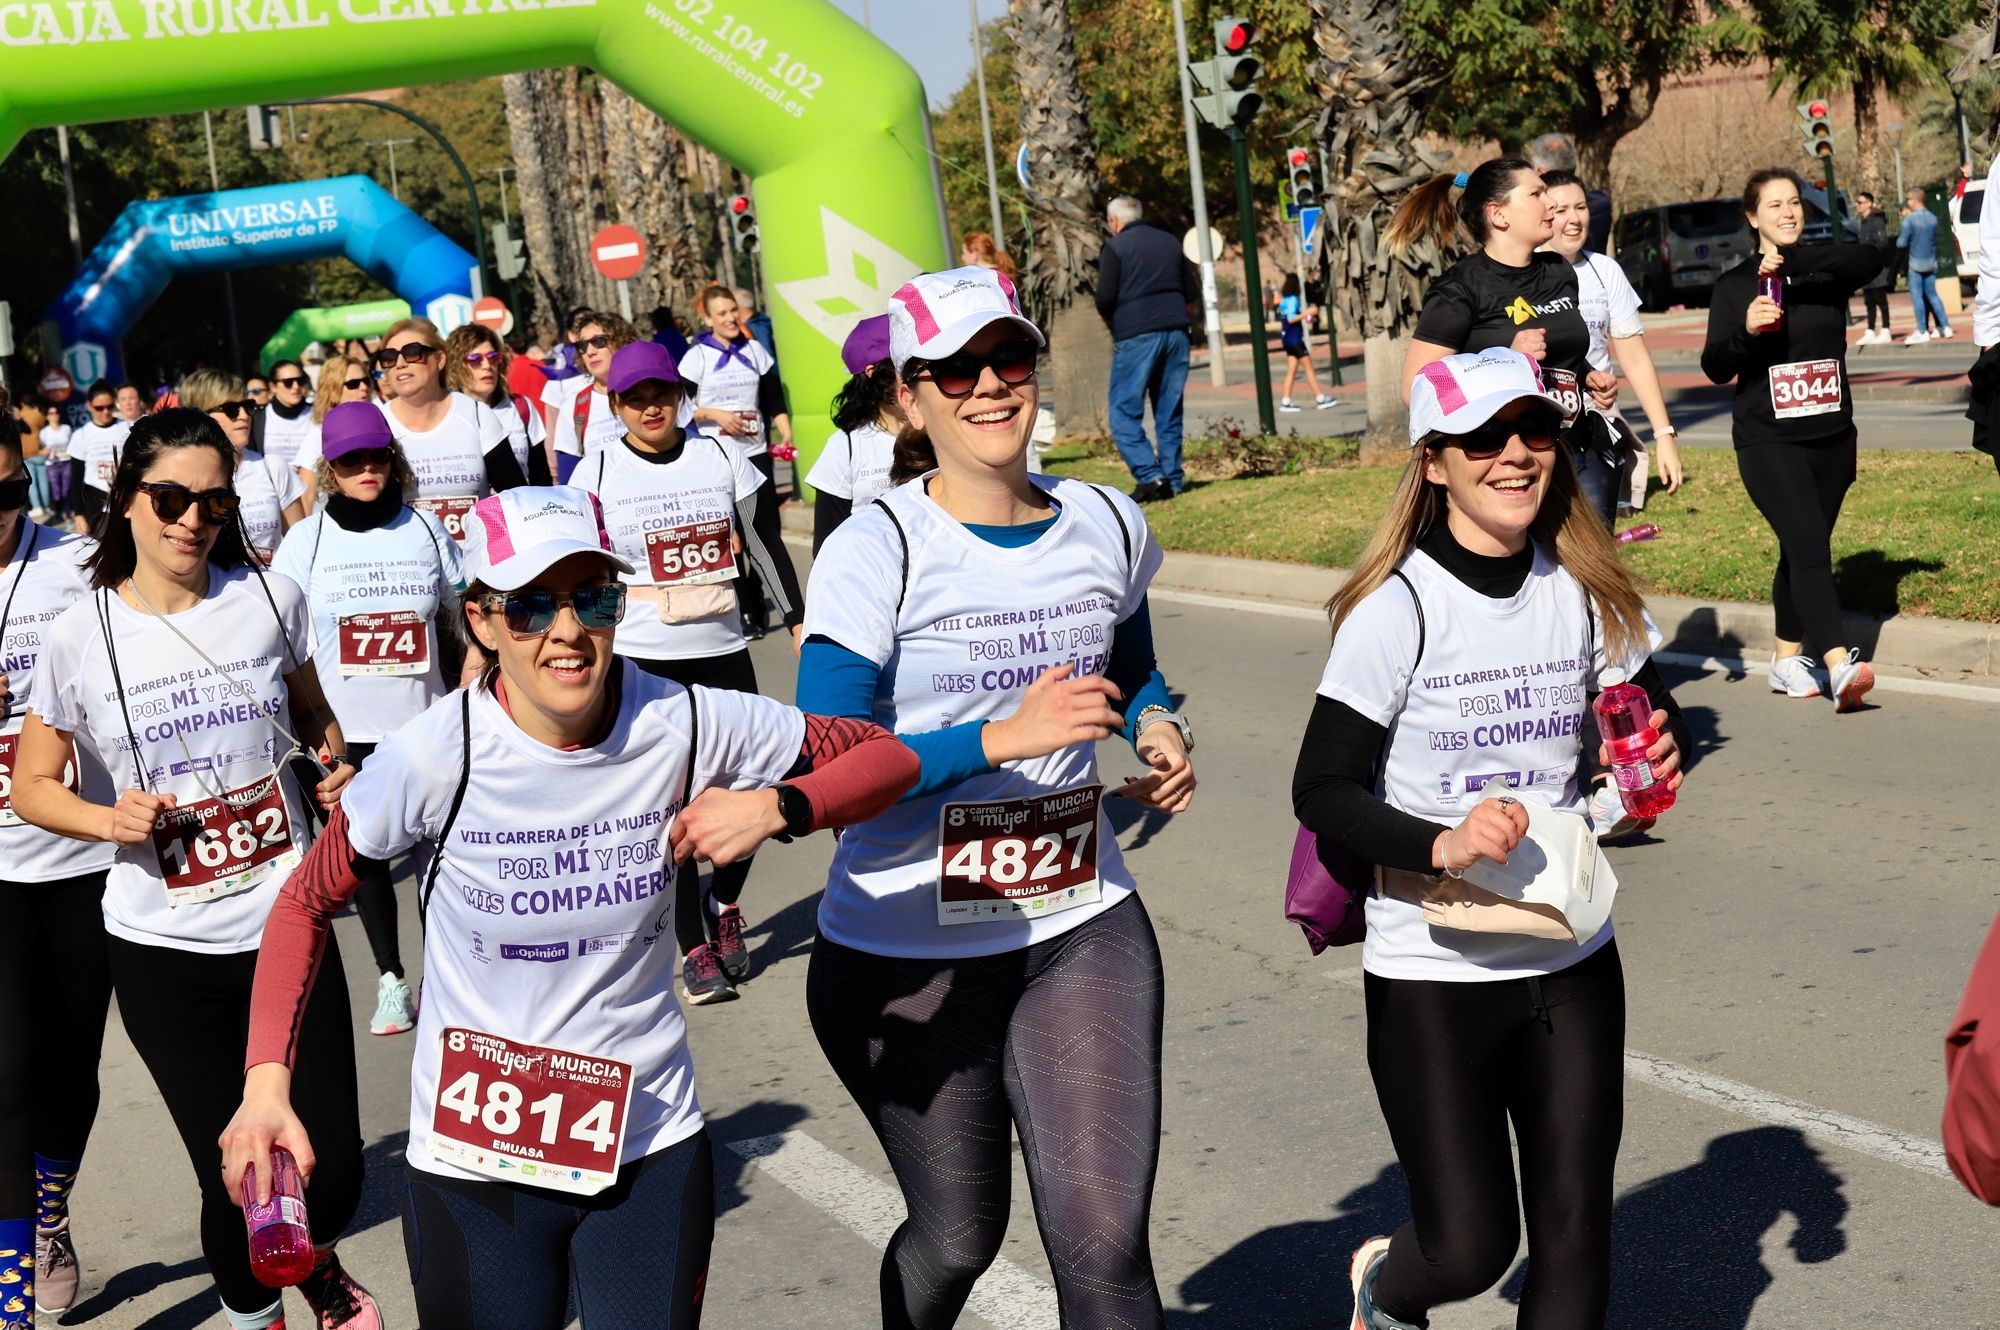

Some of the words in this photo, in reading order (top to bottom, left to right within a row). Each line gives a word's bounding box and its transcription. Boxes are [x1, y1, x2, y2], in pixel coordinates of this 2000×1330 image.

[0, 2, 131, 46] CAJA
[141, 0, 330, 39] RURAL
[644, 2, 805, 118] www.ruralcentral.es
[712, 14, 768, 62] 104
[767, 52, 823, 100] 102
[168, 195, 337, 236] UNIVERSAE
[171, 235, 229, 252] Instituto
[232, 226, 294, 245] Superior
[296, 222, 316, 236] de
[318, 219, 338, 235] FP
[1531, 296, 1573, 315] McFIT
[1775, 376, 1838, 403] 3044
[416, 473, 481, 488] MPAÑERAS
[617, 498, 632, 506] VIII
[634, 494, 668, 504] CARRERA
[669, 491, 679, 500] DE
[680, 490, 690, 498] LA
[691, 487, 713, 496] MUJER
[635, 505, 662, 518] POR
[662, 498, 682, 513] MÍ
[683, 500, 693, 510] Y
[694, 497, 720, 509] POR
[523, 511, 549, 522] AGUAS
[696, 521, 728, 533] MURCIA
[618, 523, 640, 537] MIS
[663, 531, 691, 545] mujer
[323, 565, 338, 573] VIII
[340, 562, 373, 571] CARRERA
[663, 540, 721, 574] 566
[342, 573, 368, 585] POR
[368, 567, 386, 582] MÍ
[349, 582, 438, 599] COMPAÑERAS
[4, 614, 36, 627] MUJER
[356, 617, 385, 630] mujer
[933, 619, 961, 632] VIII
[966, 611, 1026, 629] CARRERA
[1029, 608, 1045, 622] DE
[1048, 605, 1063, 619] LA
[1066, 599, 1098, 616] MUJER
[5, 631, 41, 650] POR
[352, 630, 416, 657] 774
[969, 638, 1015, 661] POR
[1019, 623, 1048, 656] MÍ
[1051, 630, 1066, 651] Y
[1069, 624, 1103, 648] POR
[128, 675, 177, 697] CARRERA
[180, 670, 195, 682] DE
[198, 667, 212, 679] LA
[251, 656, 269, 669] 2023
[932, 674, 975, 694] MIS
[1423, 675, 1451, 689] VIII
[1454, 667, 1510, 686] CARRERA
[1513, 666, 1528, 679] DE
[1529, 664, 1544, 676] LA
[1546, 659, 1577, 674] MUJER
[131, 698, 169, 722] POR
[171, 682, 200, 710] MÍ
[201, 686, 216, 702] Y
[219, 679, 256, 700] POR
[1459, 694, 1503, 717] POR
[1504, 679, 1532, 711] MÍ
[1534, 688, 1546, 707] Y
[1550, 684, 1580, 706] POR
[144, 697, 281, 744] COMPAÑERAS
[1429, 731, 1468, 750] MIS
[167, 806, 195, 818] carrera
[969, 805, 1005, 815] carrera
[1043, 790, 1094, 814] MURCIA
[176, 805, 220, 827] mujer
[979, 809, 1031, 834] mujer
[1043, 814, 1048, 822] 5
[1049, 812, 1058, 821] DE
[1058, 806, 1080, 818] MARZO
[461, 829, 491, 844] VIII
[495, 828, 566, 844] CARRERA
[571, 825, 589, 840] DE
[594, 821, 612, 836] LA
[615, 810, 661, 832] MUJER
[162, 807, 288, 876] 1682
[945, 820, 1094, 884] 4827
[214, 860, 252, 878] CARMEN
[499, 857, 550, 880] POR
[555, 839, 590, 876] MÍ
[594, 848, 614, 871] Y
[618, 838, 662, 868] POR
[462, 885, 505, 915] MIS
[1004, 884, 1049, 897] EMUASA
[470, 1034, 507, 1051] carrera
[478, 1045, 533, 1076] mujer
[551, 1055, 622, 1079] MURCIA
[549, 1070, 554, 1078] 5
[555, 1071, 567, 1080] DE
[569, 1073, 600, 1085] MARZO
[600, 1078, 622, 1088] 2023
[440, 1071, 616, 1153] 4814
[493, 1139, 545, 1159] EMUASA
